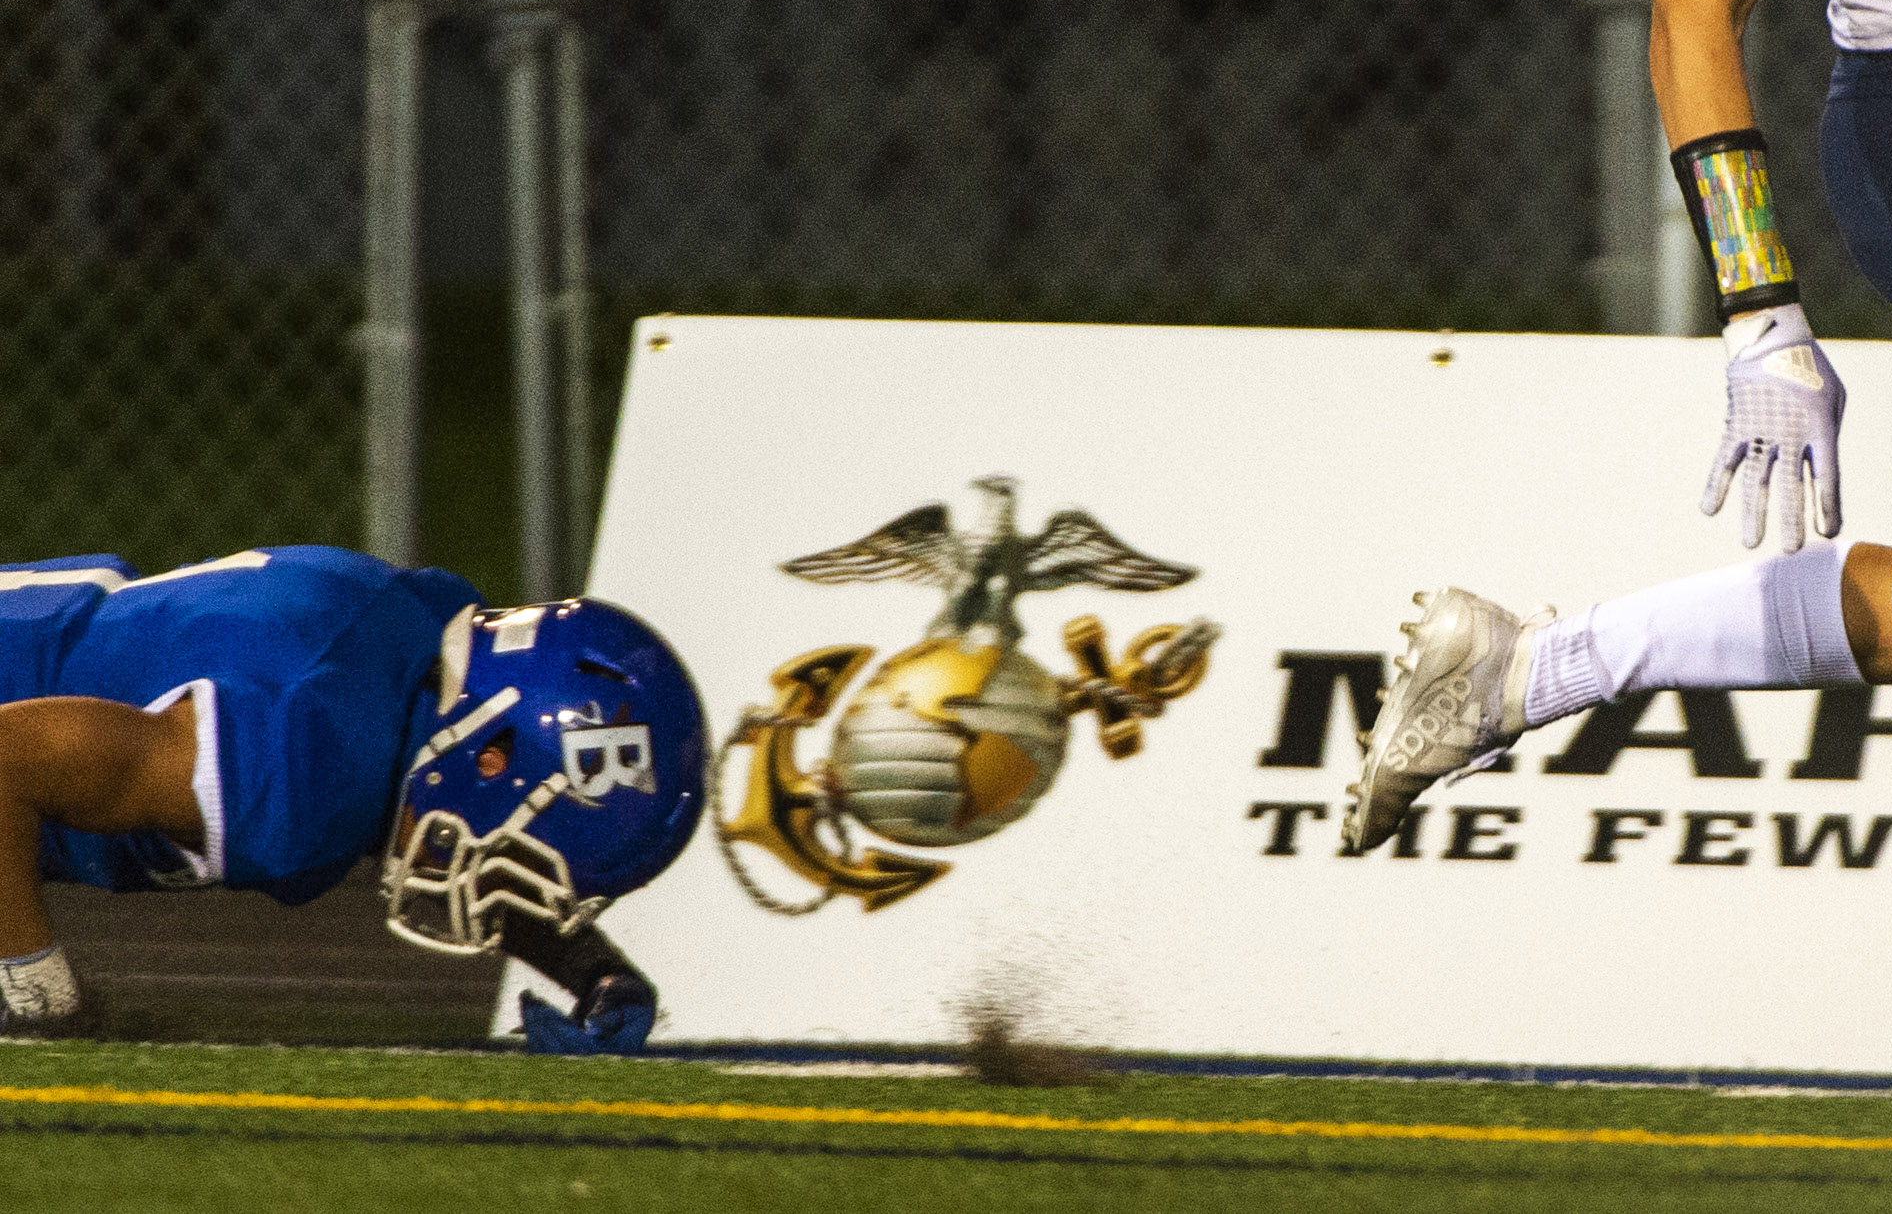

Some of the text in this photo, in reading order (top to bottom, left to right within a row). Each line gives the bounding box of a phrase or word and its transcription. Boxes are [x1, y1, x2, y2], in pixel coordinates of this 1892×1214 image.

[1384, 674, 1474, 772] adidas
[562, 724, 657, 798] B
[1246, 800, 1524, 862] THE
